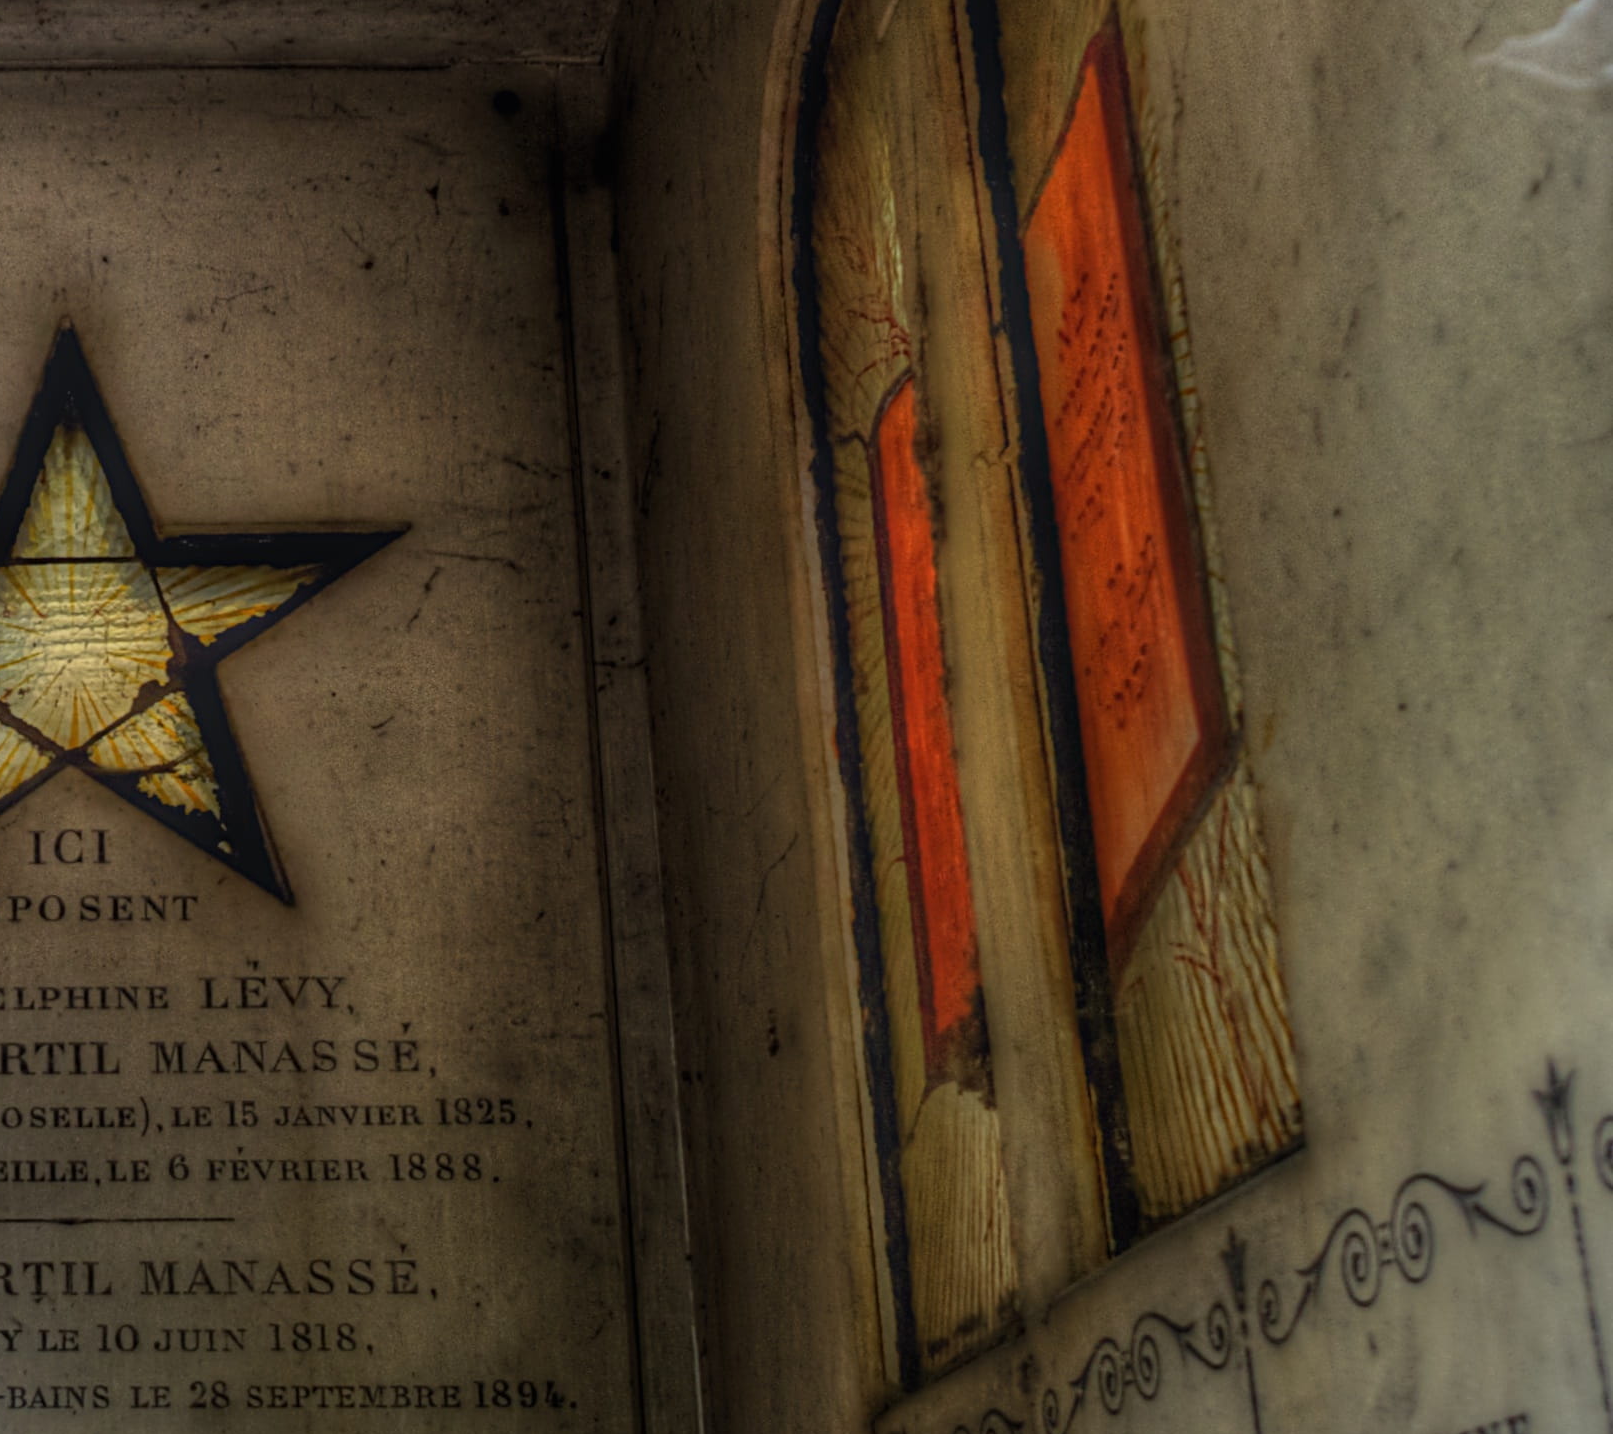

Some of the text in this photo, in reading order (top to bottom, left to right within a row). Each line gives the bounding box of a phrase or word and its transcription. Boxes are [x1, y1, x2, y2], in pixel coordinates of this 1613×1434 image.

[25, 826, 113, 867] ICI
[149, 1020, 439, 1082] MANASSÉ,
[171, 1103, 216, 1132] LE
[223, 1098, 261, 1131] 15
[273, 1099, 425, 1131] JANVIER
[106, 1155, 152, 1186] LE
[166, 1153, 191, 1186] 6
[206, 1145, 370, 1185] FÉVRIER
[36, 1324, 81, 1355] LE
[94, 1323, 141, 1356] 10
[151, 1324, 248, 1357] JUIN
[129, 1379, 174, 1412] LE
[187, 1377, 232, 1412] 28
[245, 1379, 464, 1412] SEPTEMBRE
